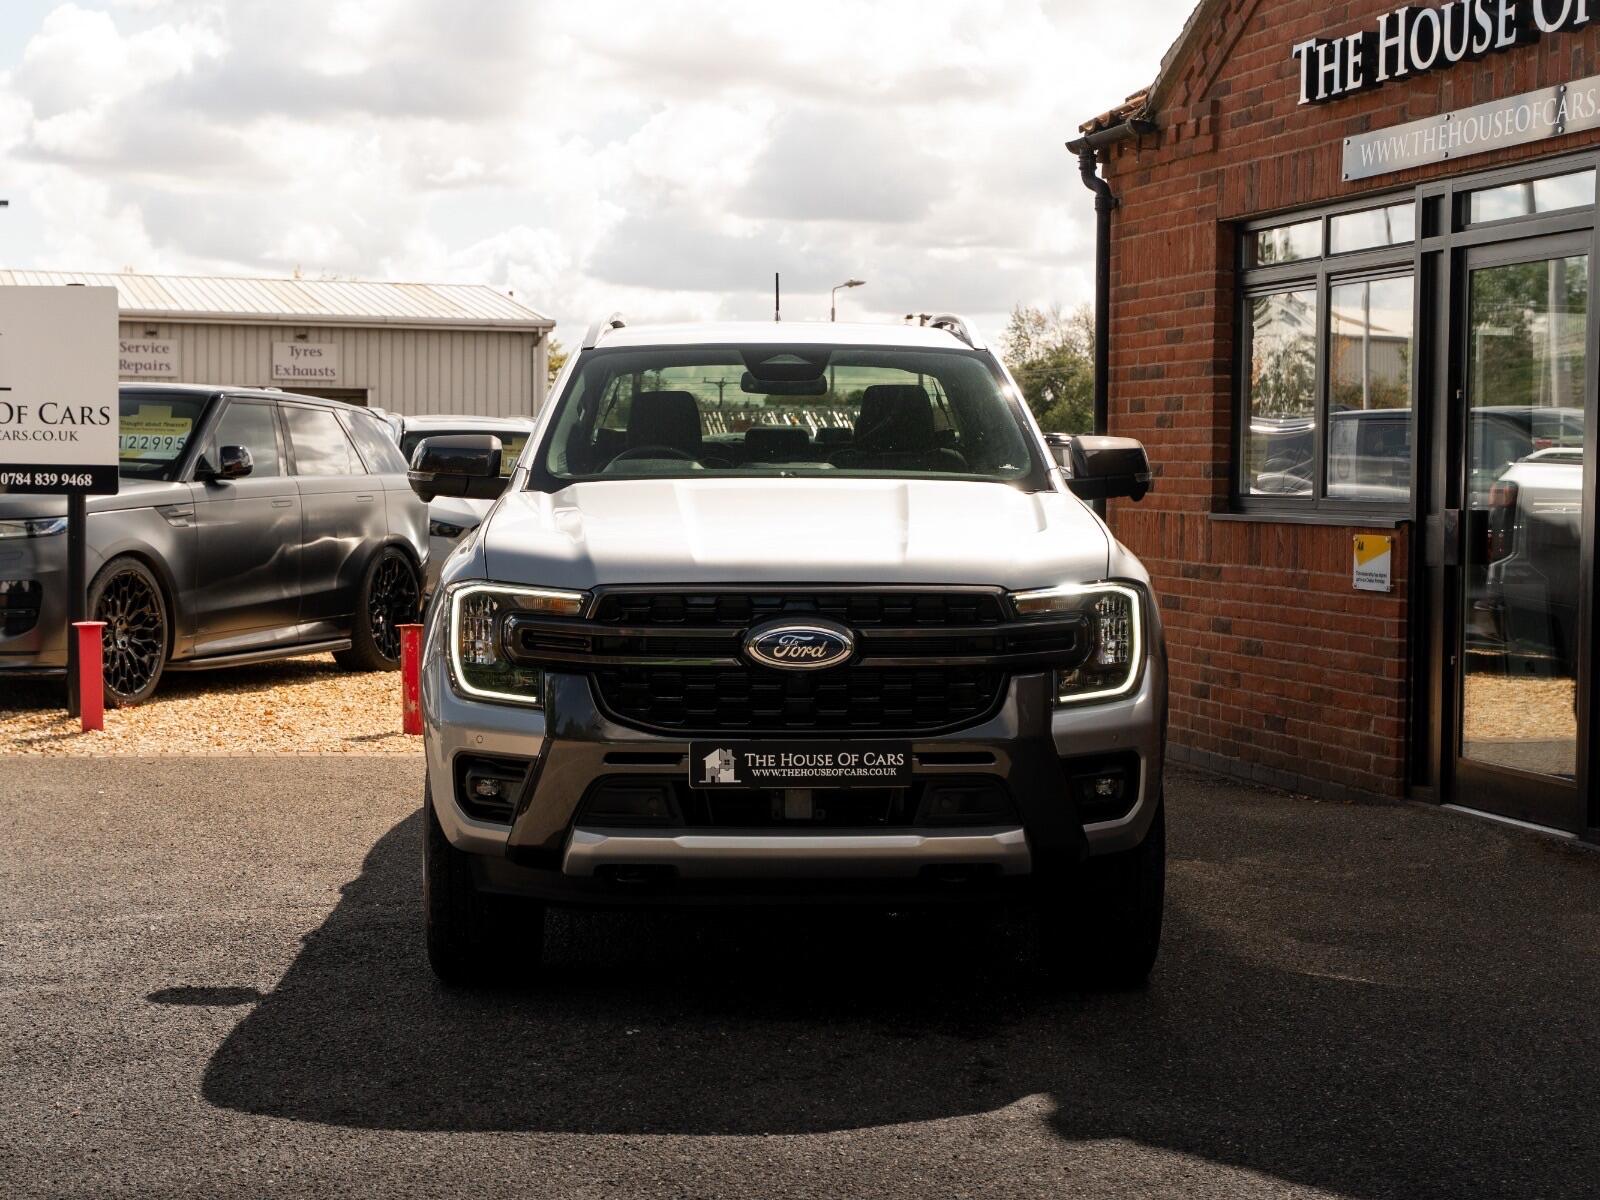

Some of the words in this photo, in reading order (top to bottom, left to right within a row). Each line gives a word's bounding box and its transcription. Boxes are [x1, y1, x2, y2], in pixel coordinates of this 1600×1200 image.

[1292, 31, 1363, 105] THE
[1376, 0, 1517, 82] HOUSE
[119, 341, 170, 354] Service
[288, 345, 323, 359] Tyres
[119, 359, 171, 374] Repairs
[275, 364, 336, 377] Exhausts
[38, 402, 110, 426] CARS
[0, 430, 79, 441] ARS.CO.UK
[0, 472, 31, 486] 0784
[34, 473, 58, 486] 839
[61, 474, 93, 486] 9468
[773, 634, 827, 658] Ford
[744, 753, 776, 767] THE
[780, 753, 834, 767] HOUSE
[837, 752, 859, 766] OF
[863, 752, 904, 766] CARS
[752, 767, 897, 777] WWW.THEHOUSEOFCARS.CO.UK
